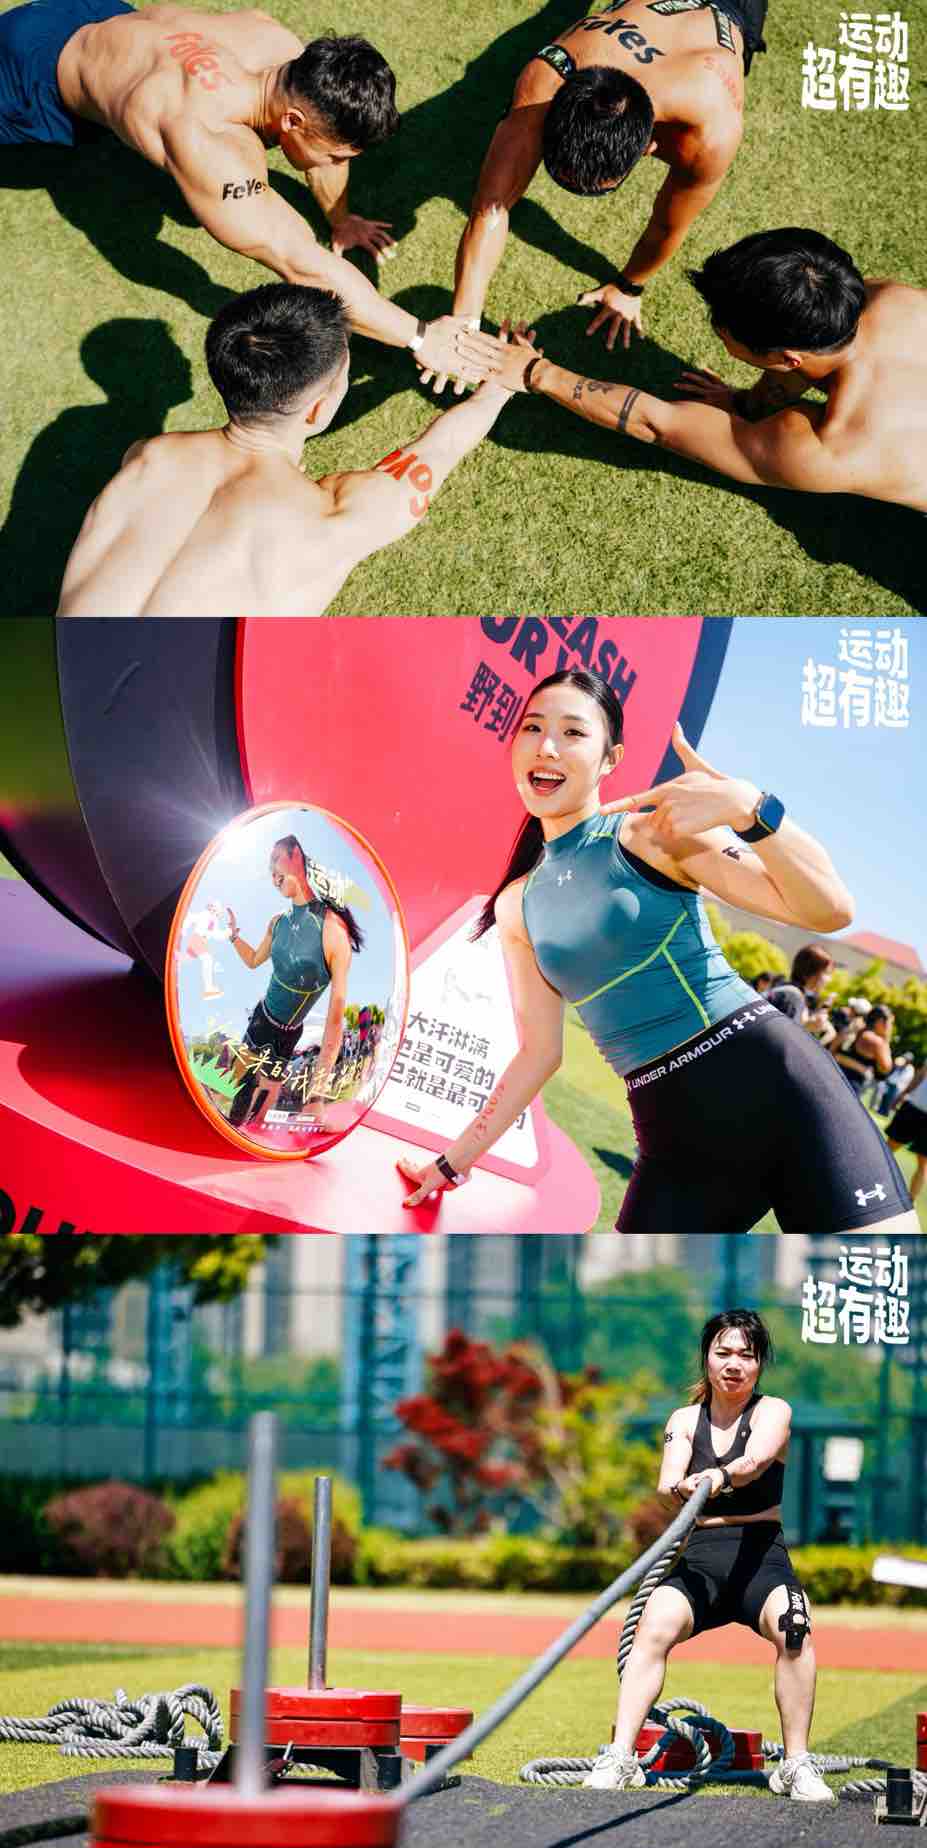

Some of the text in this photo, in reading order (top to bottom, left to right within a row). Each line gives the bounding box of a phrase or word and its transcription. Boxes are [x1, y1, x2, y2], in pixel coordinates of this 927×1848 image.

[408, 1011, 490, 1060] 大汗淋漓
[632, 1027, 733, 1088] UNDER ARMOUR
